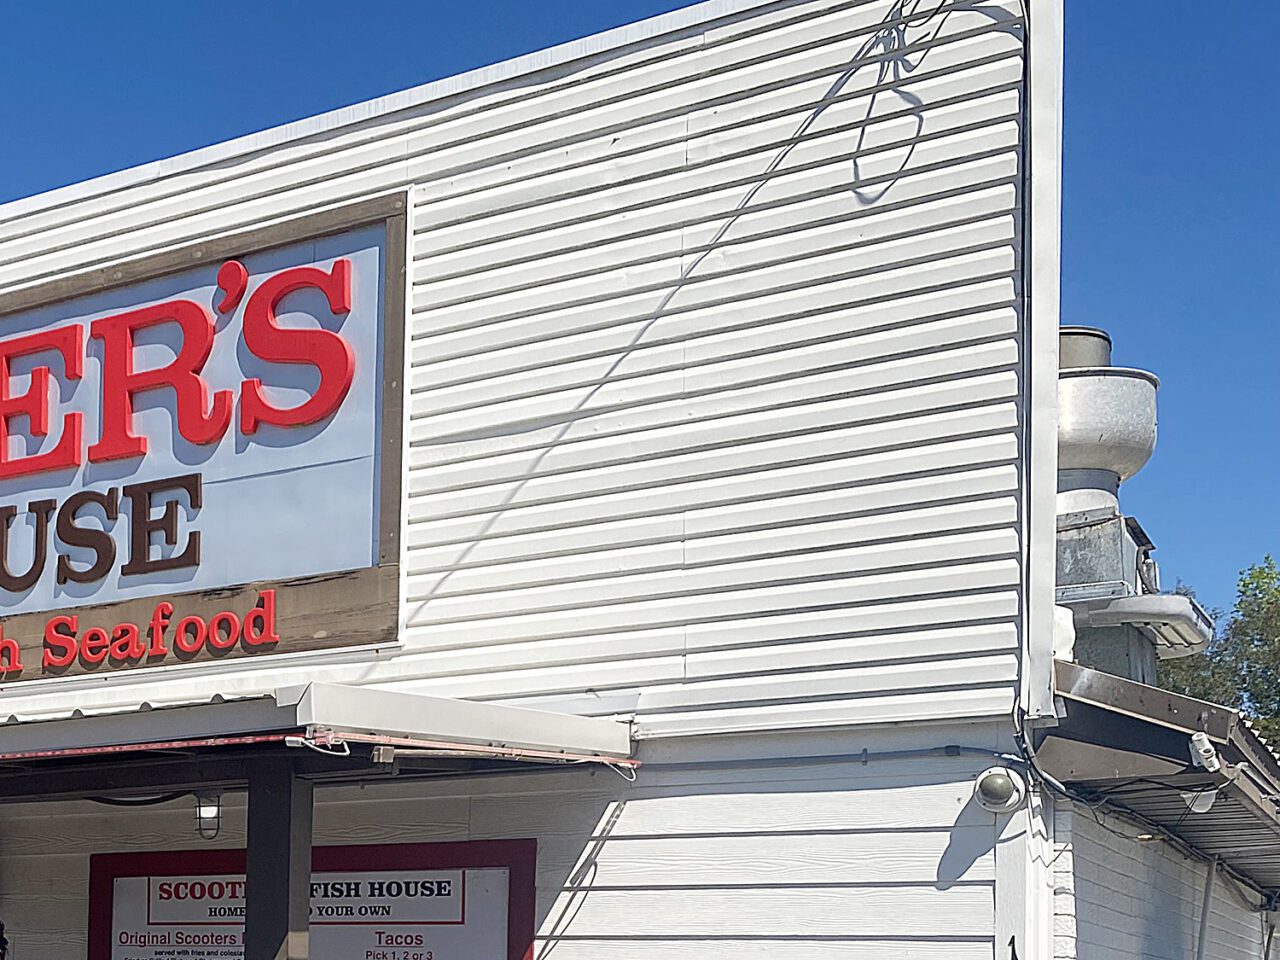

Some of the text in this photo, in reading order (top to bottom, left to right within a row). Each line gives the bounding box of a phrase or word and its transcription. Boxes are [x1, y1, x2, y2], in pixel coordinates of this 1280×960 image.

[42, 589, 280, 669] Seafood
[159, 880, 451, 900] SCOOT FISH HOUSE
[317, 906, 354, 916] YOUR
[358, 906, 391, 916] OWN
[119, 931, 170, 947] Original
[176, 932, 236, 945] Scooters
[375, 931, 423, 946] Tacos
[366, 950, 388, 960] Pick
[403, 951, 409, 960] 2
[426, 951, 433, 960] 3
